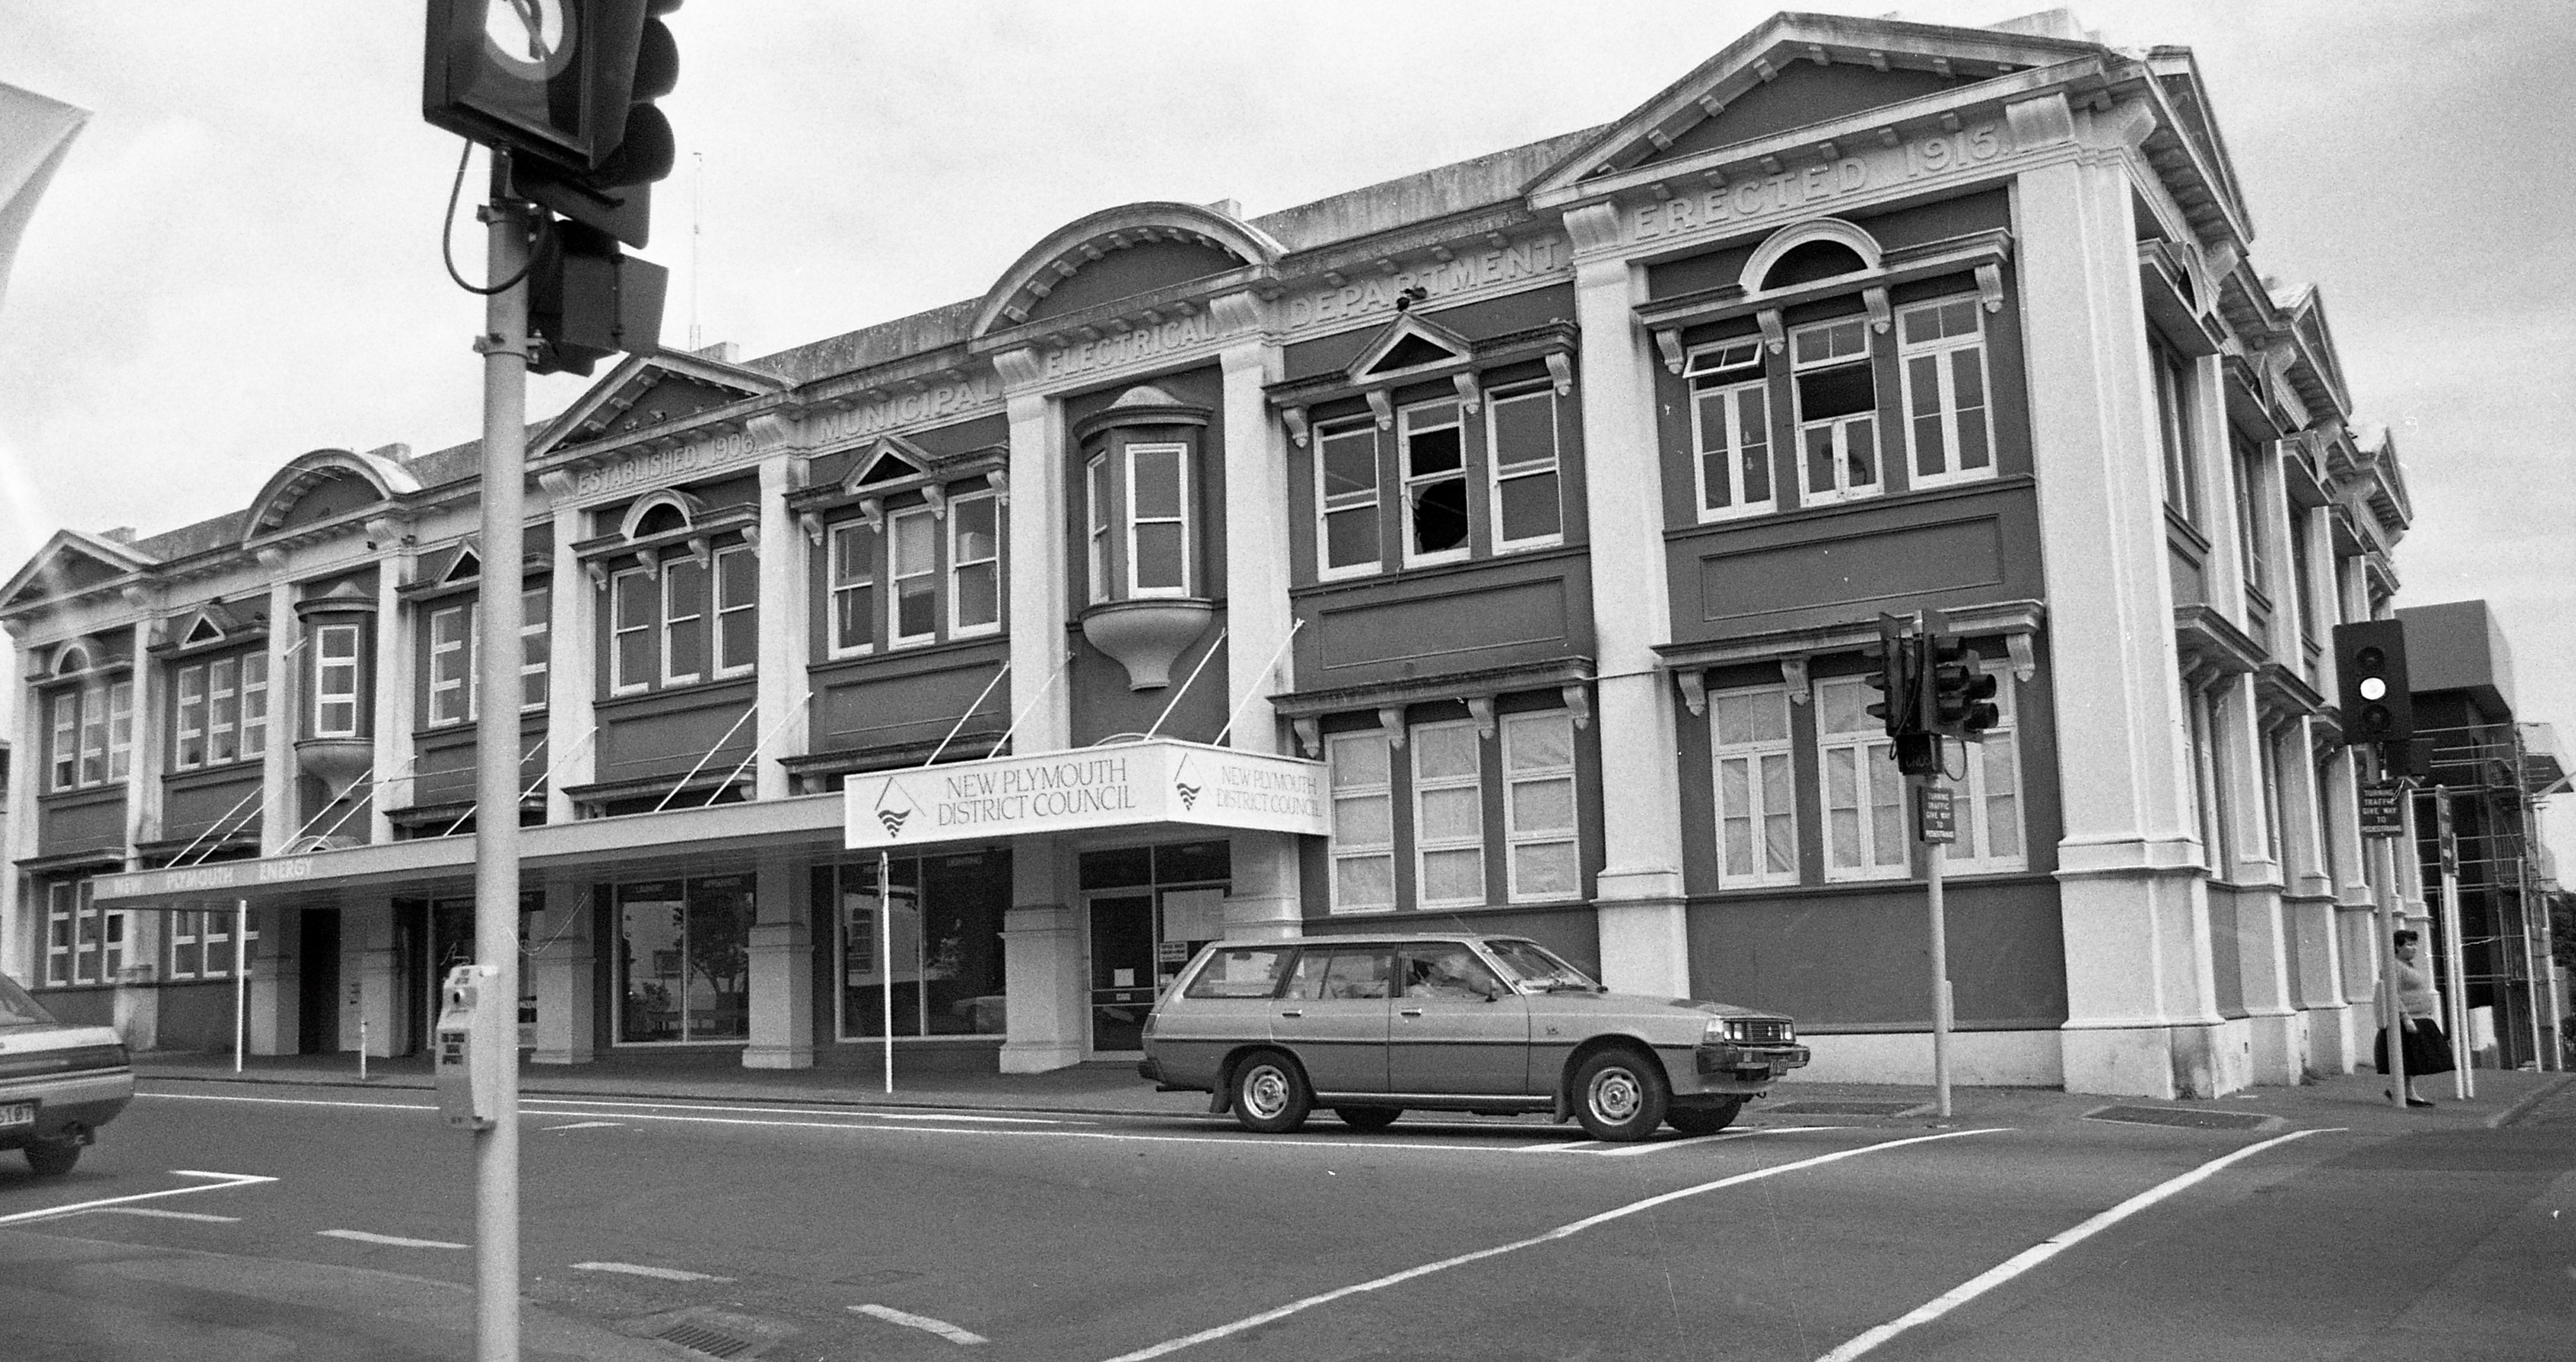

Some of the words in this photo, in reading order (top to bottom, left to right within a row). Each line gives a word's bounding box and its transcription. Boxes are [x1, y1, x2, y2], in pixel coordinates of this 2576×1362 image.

[1632, 157, 1868, 240] ERECTED
[1290, 238, 1560, 329] DEPARTMENT
[1047, 313, 1216, 380] ELECTRICAL
[821, 378, 1004, 443] MUNICIPAL
[578, 446, 697, 498] ESTABLISHED
[947, 772, 997, 799] NEW
[1003, 758, 1126, 794] PLYMOUTH
[1222, 765, 1250, 786] NEW
[1254, 770, 1316, 794] PLYMOUTH
[939, 795, 1028, 826] DISTRICT
[1033, 785, 1135, 817] COUNCIL
[1217, 787, 1268, 811] DISTRICT
[1271, 794, 1323, 817] COUNCIL
[114, 877, 142, 894] NEW
[166, 867, 234, 891] PLYMOUTH
[259, 857, 312, 881] ENERGY
